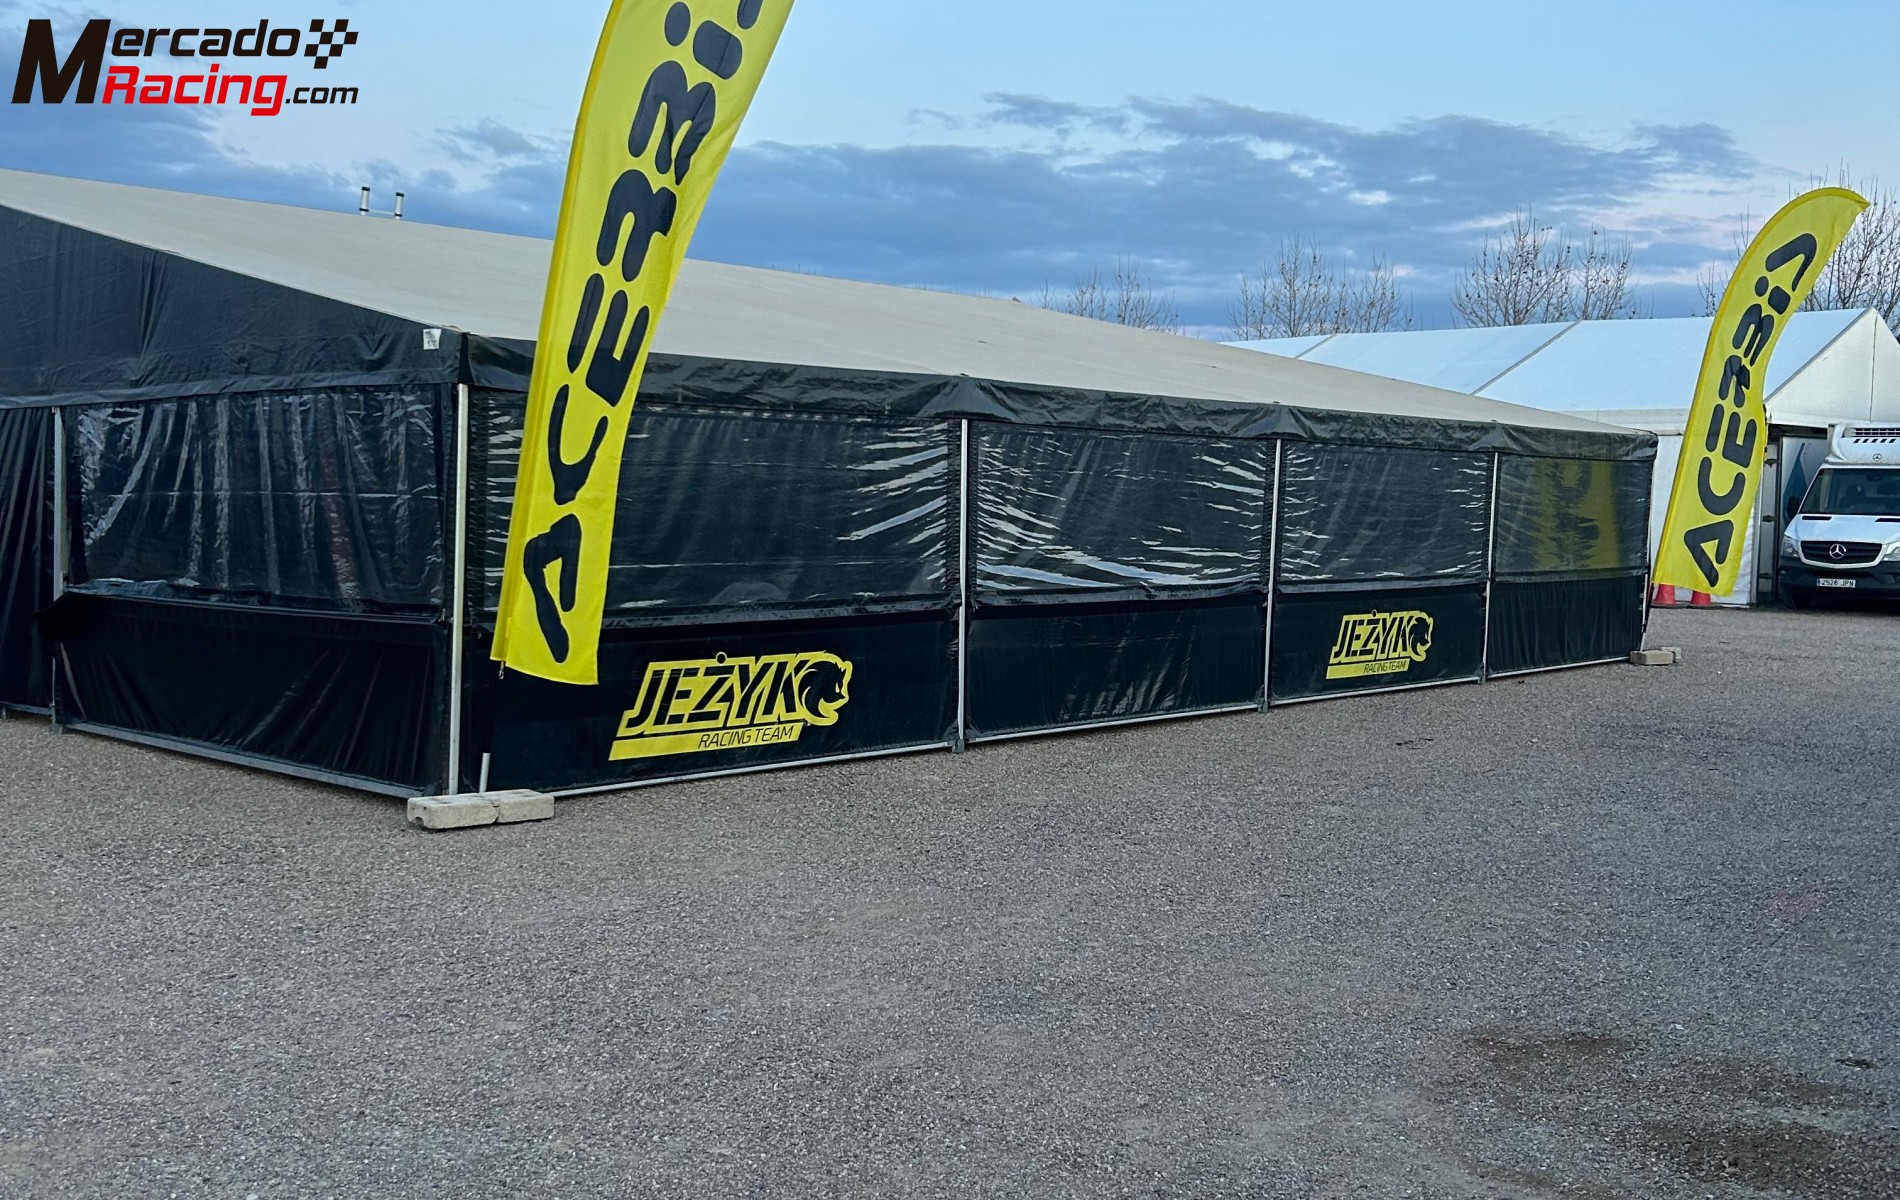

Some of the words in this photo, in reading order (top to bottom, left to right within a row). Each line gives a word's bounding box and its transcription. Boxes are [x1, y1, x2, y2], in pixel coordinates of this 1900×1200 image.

[523, 0, 764, 663] ACERBI
[1363, 661, 1388, 674] RACING
[1388, 660, 1407, 672] TEAM
[697, 729, 752, 749] RACING
[755, 725, 794, 744] TEAM
